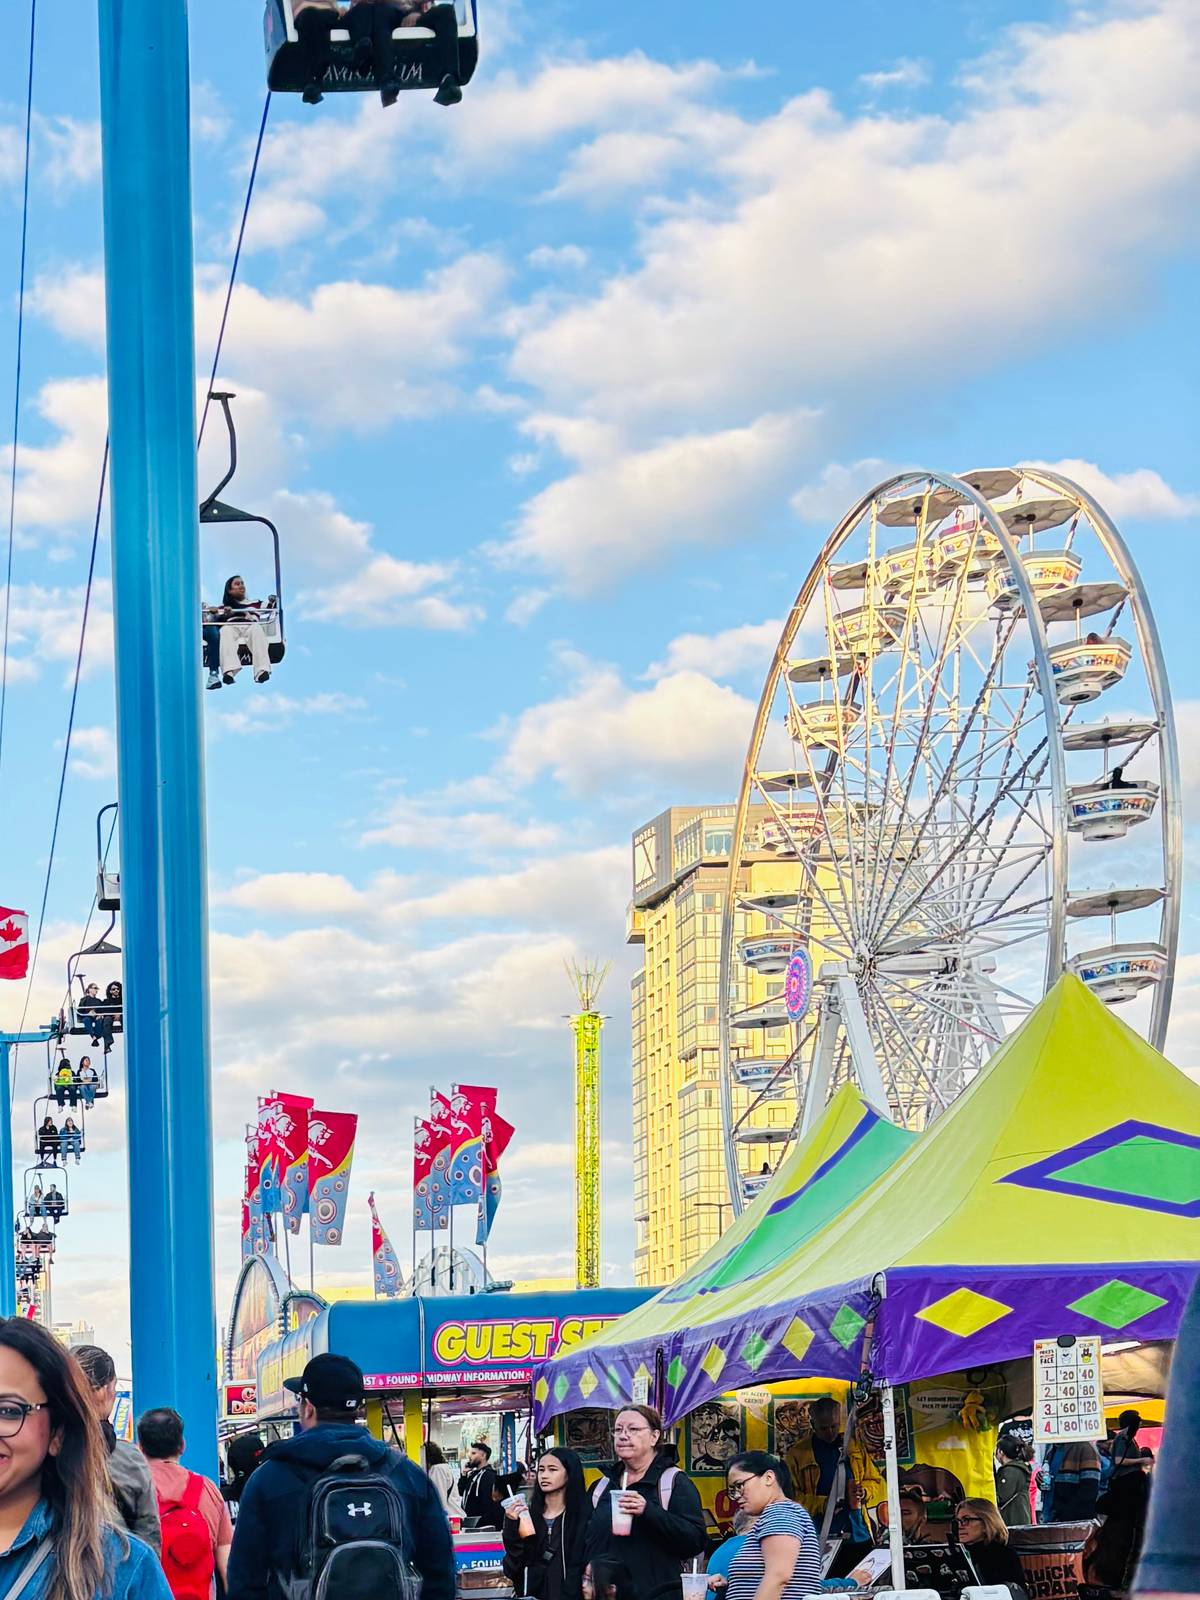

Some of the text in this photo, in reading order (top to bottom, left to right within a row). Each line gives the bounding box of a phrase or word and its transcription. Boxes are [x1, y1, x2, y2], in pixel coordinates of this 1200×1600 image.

[436, 1321, 553, 1362] GUEST
[386, 1374, 418, 1385] FOUND
[426, 1372, 461, 1384] MIDWAY
[464, 1370, 524, 1382] INFORMATION
[471, 1560, 501, 1569] FOUN
